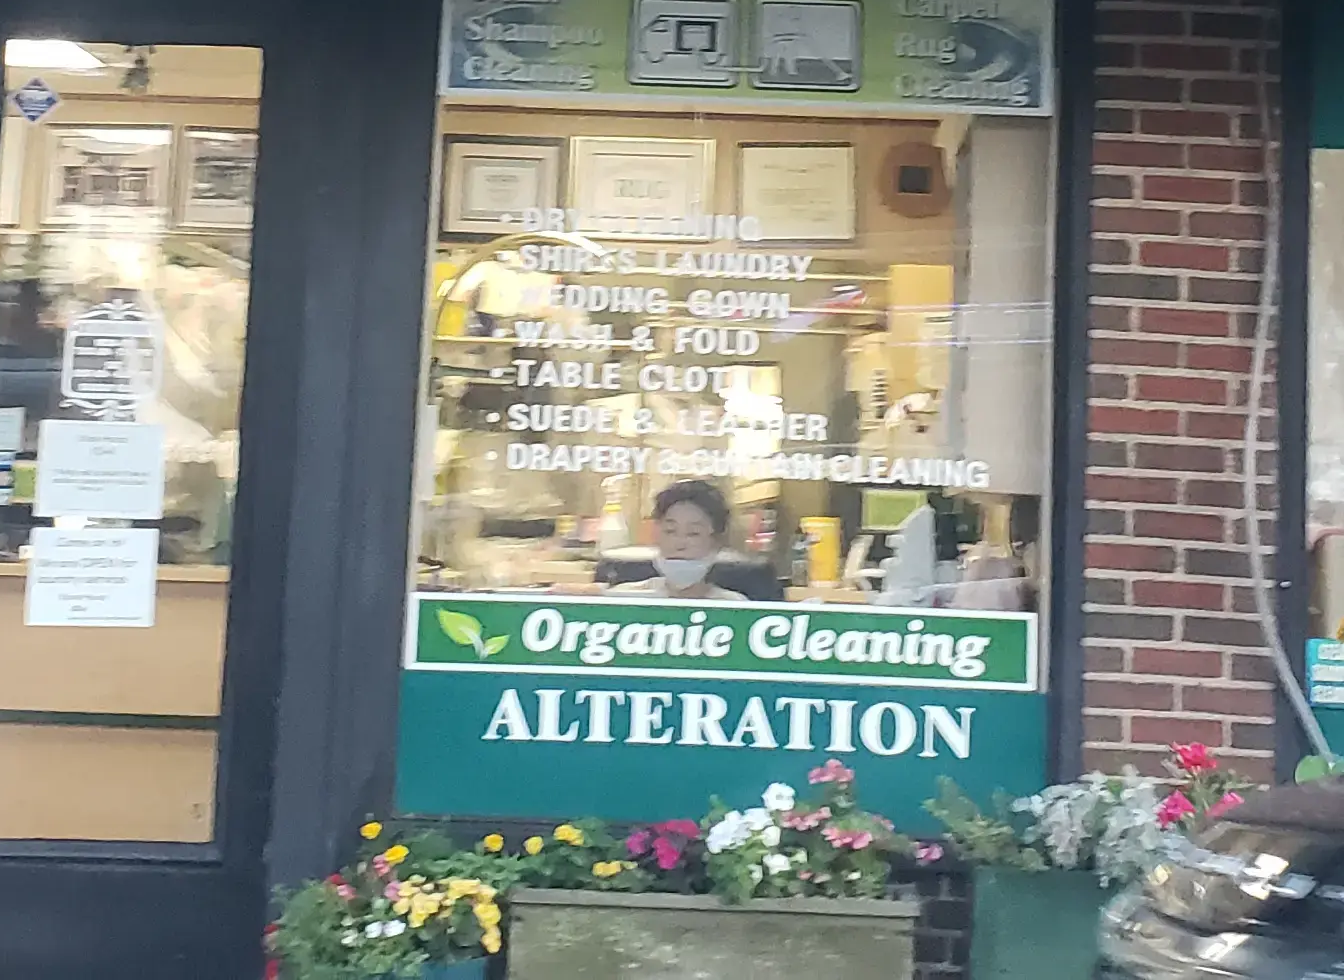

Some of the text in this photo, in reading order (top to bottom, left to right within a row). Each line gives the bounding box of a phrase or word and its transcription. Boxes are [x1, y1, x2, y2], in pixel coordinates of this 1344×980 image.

[894, 32, 957, 64] Rug
[657, 249, 813, 283] LAUNDRY
[686, 289, 792, 320] GOWN
[514, 320, 761, 357] WASH & FOLD
[513, 359, 622, 390] TABLE
[507, 442, 653, 474] DRAPERY
[827, 453, 991, 488] CLEANING
[521, 607, 992, 677] Organic Cleaning
[481, 687, 977, 760] ALTERATION
